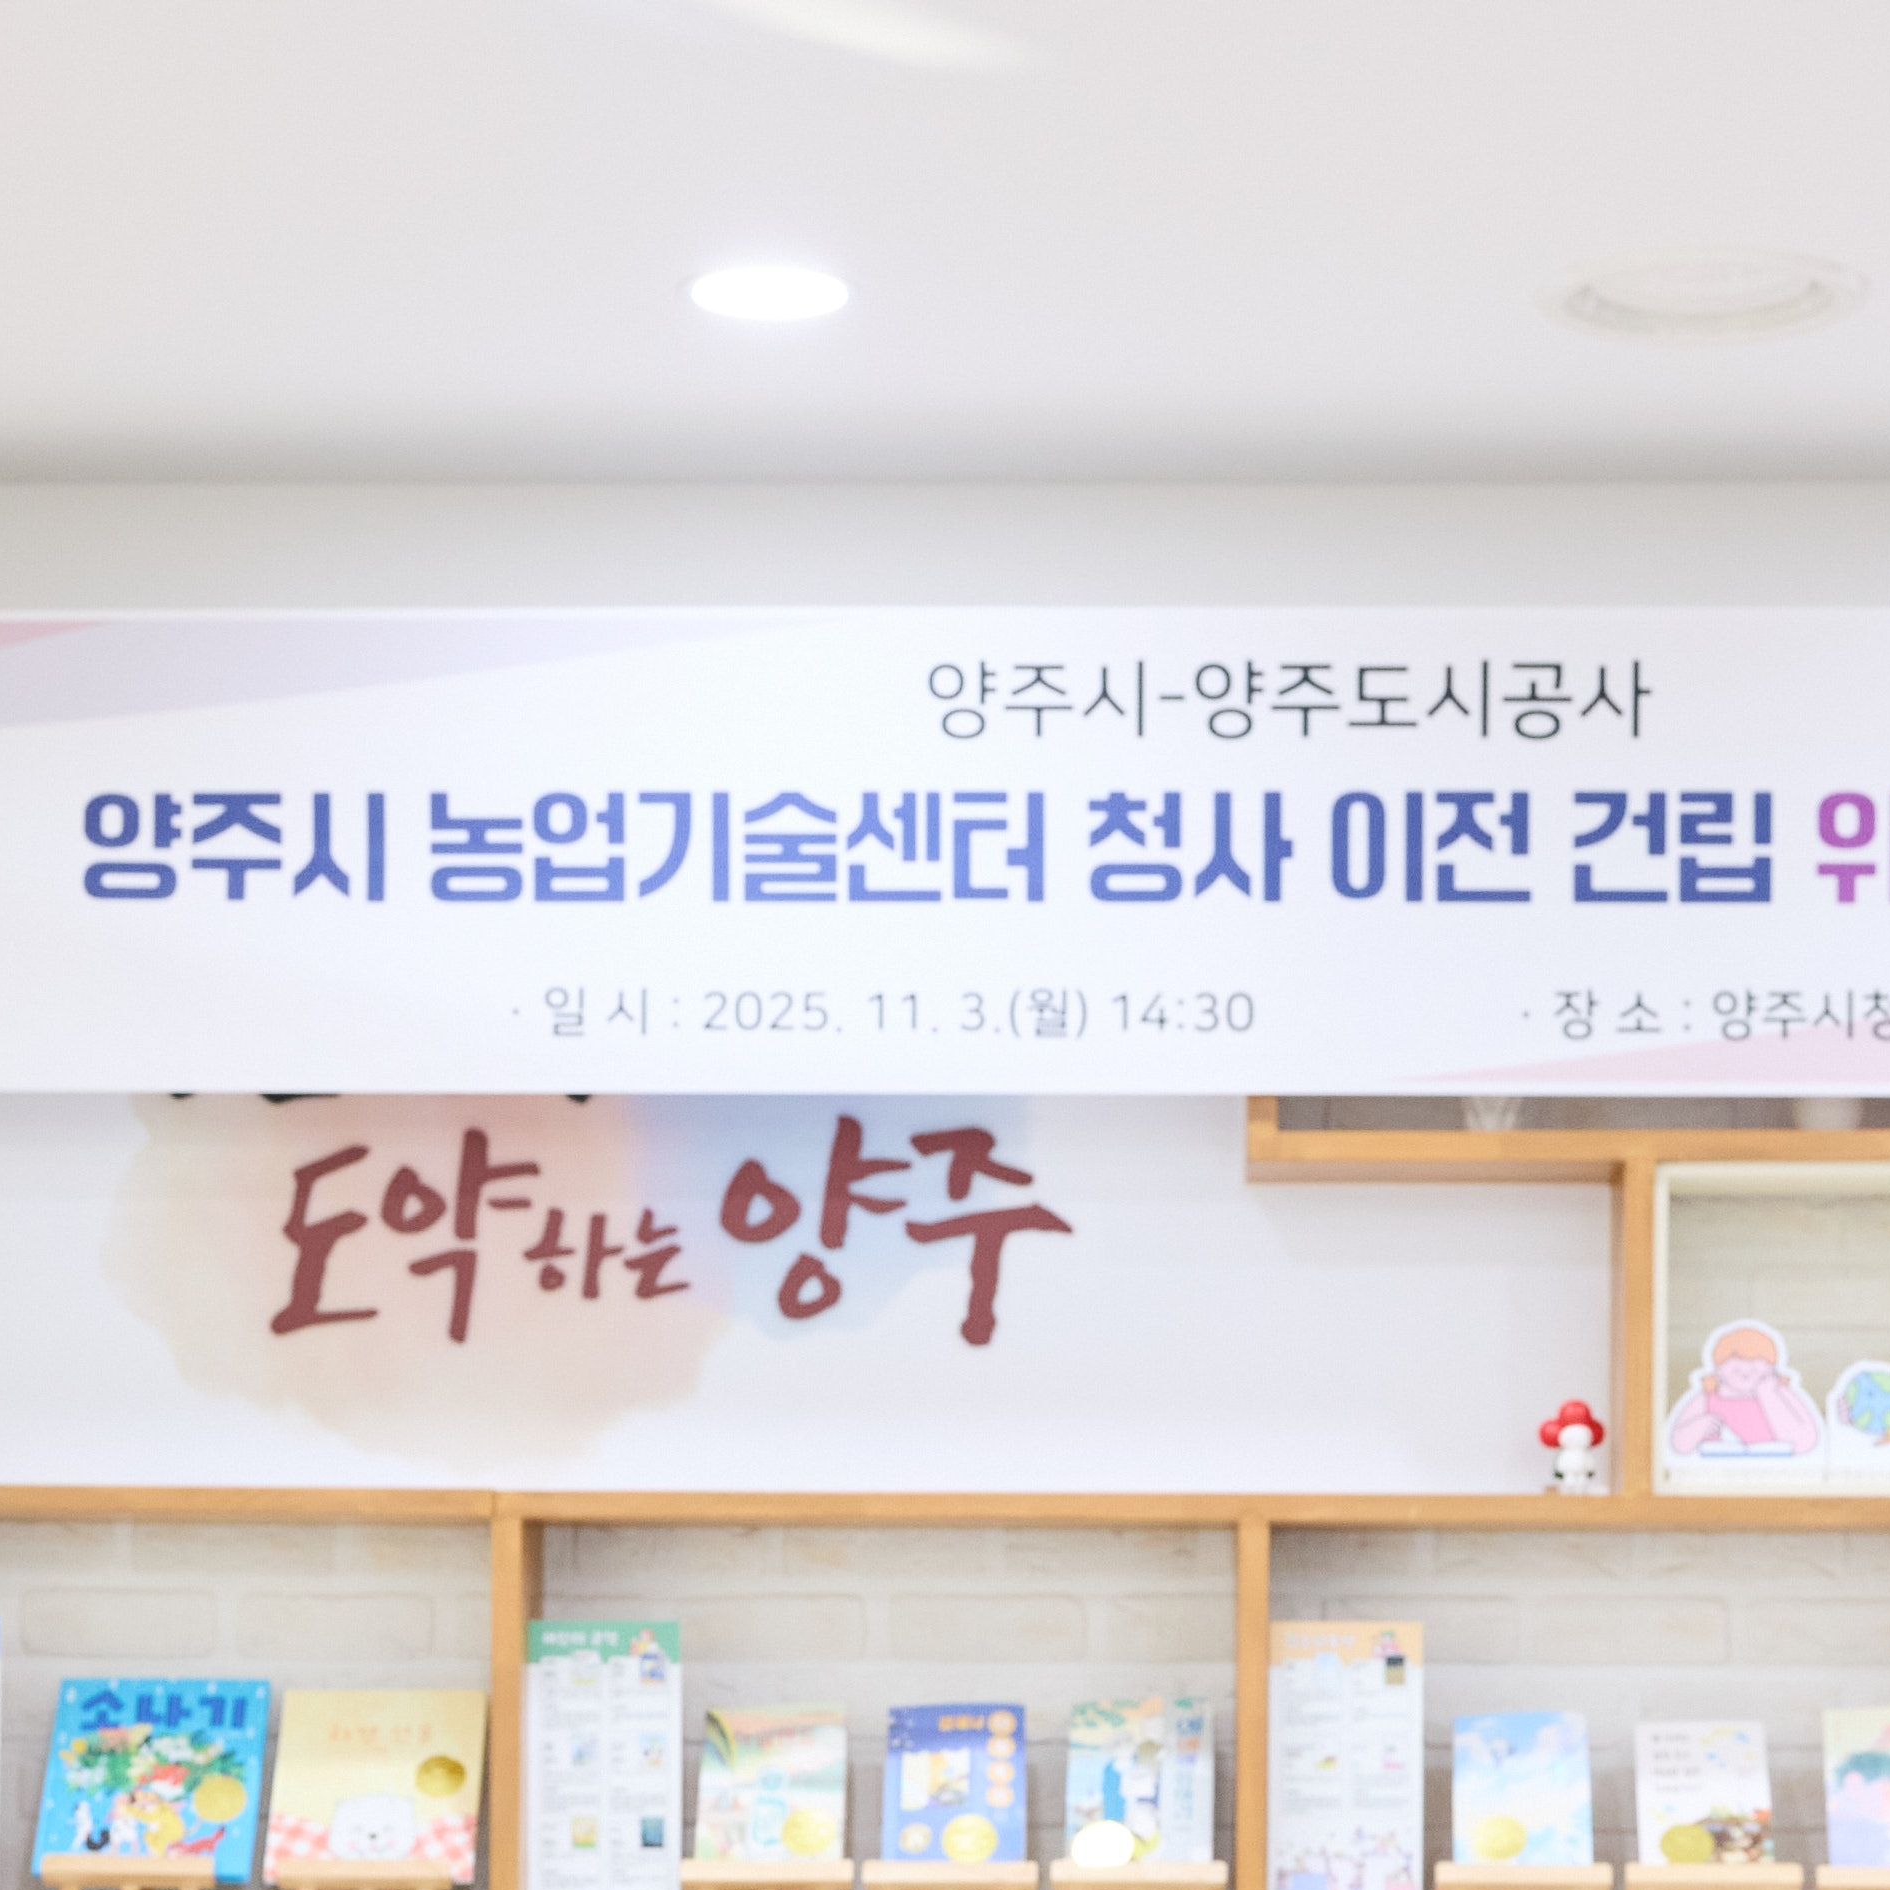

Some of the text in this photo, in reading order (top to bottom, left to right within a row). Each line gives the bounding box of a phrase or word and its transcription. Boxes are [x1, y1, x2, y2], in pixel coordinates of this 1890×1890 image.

[928, 660, 1652, 740] 양주시-양주도시공사
[84, 793, 386, 902] 양주시
[430, 792, 1045, 903] 농업기술센터
[1089, 791, 1294, 903] 청사
[1332, 791, 1531, 903] 이전
[1574, 791, 1773, 903] 건립
[702, 990, 843, 1032] 2025.
[869, 992, 939, 1033] 11.
[961, 988, 1088, 1038] 3.(월)
[1112, 991, 1255, 1033] 14:30
[719, 1113, 1073, 1347] 양주
[81, 1690, 246, 1730] 소나기
